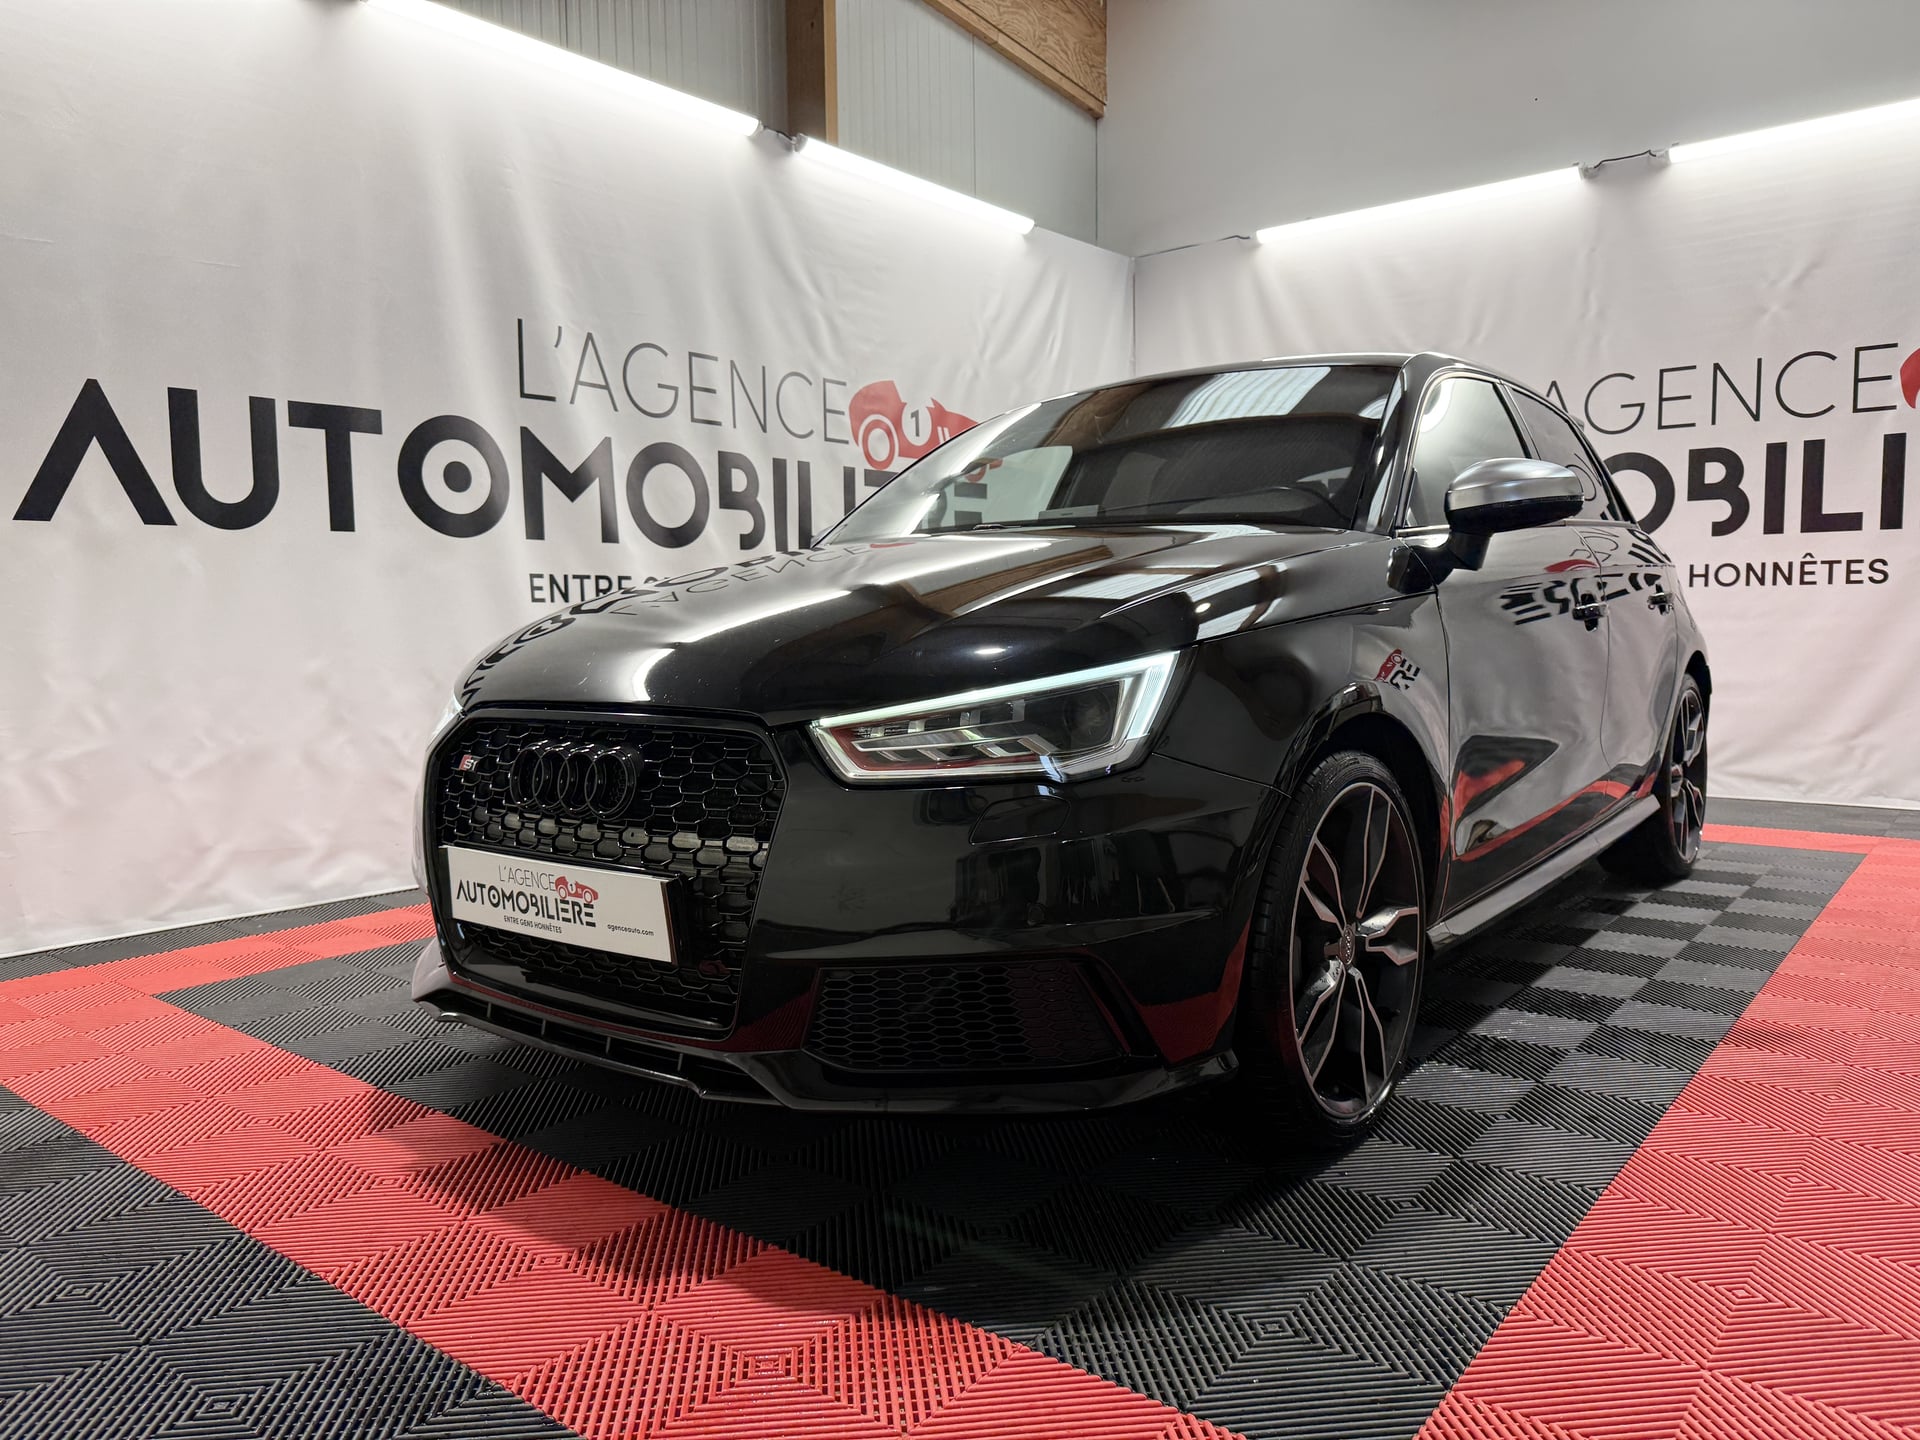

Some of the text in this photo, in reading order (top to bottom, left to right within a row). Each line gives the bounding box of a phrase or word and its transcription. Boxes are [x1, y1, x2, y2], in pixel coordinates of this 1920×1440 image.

[516, 318, 850, 445] L'AGENCE
[1688, 553, 1890, 588] HONNÊTES
[498, 864, 557, 892] L'AGENCE
[456, 879, 597, 928] AUTOMOBILIERE
[503, 915, 519, 925] ENTRE
